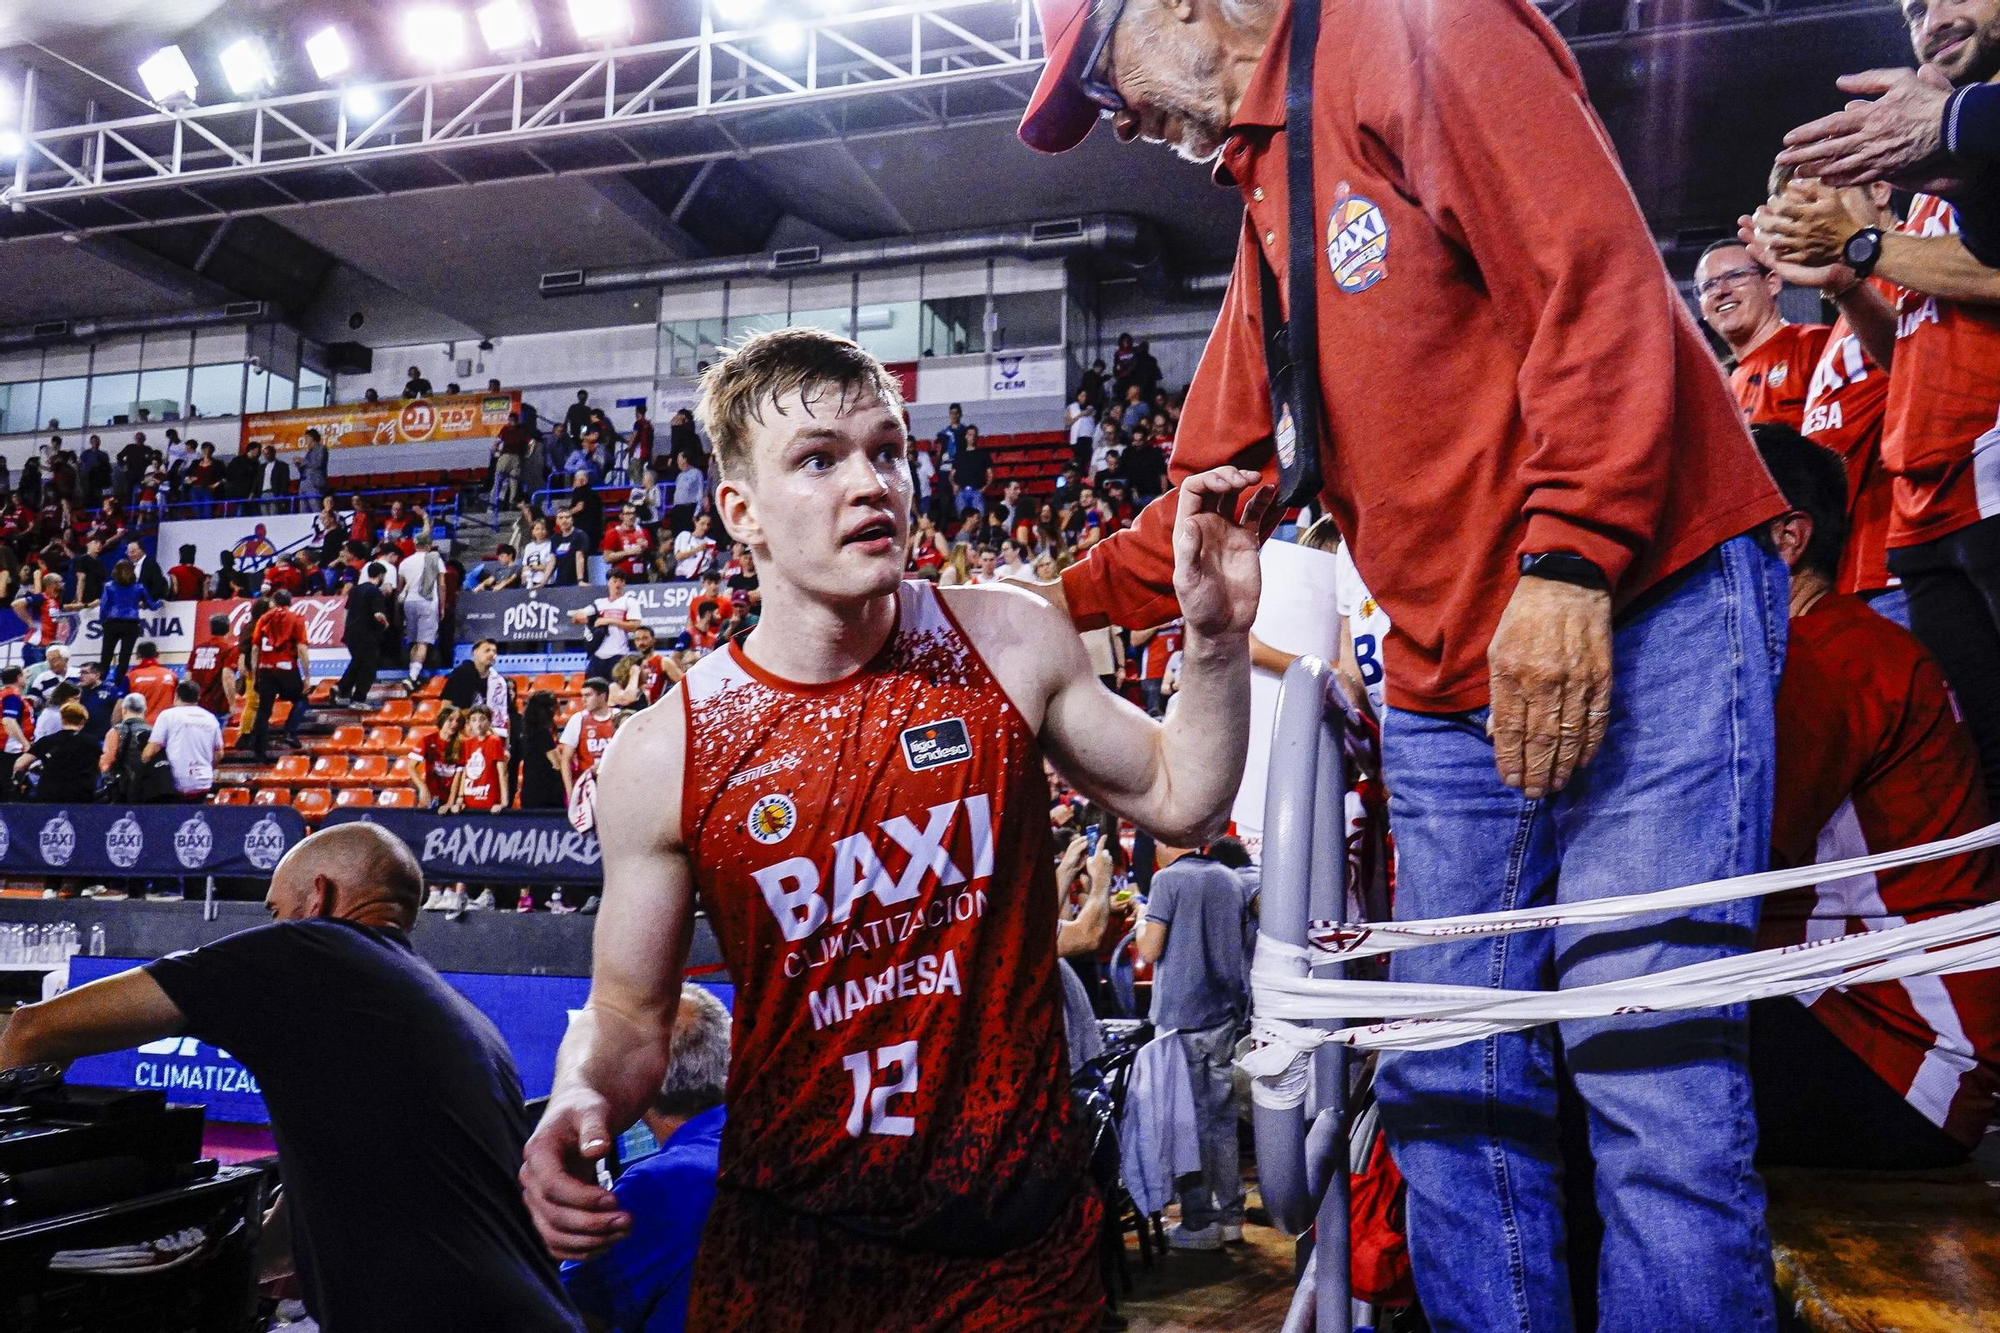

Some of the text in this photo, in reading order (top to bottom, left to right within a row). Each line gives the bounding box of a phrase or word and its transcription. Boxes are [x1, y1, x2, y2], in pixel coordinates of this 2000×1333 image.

[1327, 207, 1387, 272] BAXI
[994, 381, 1026, 391] CEM
[503, 601, 560, 636] POSTE
[909, 739, 937, 753] liga
[914, 744, 968, 764] endesa
[41, 833, 74, 847] BAXI
[107, 833, 143, 848] BAXI
[175, 833, 211, 849] BAXI
[246, 834, 285, 850] BAXI
[750, 793, 995, 942] BAXI
[808, 950, 962, 1031] MANRESA
[843, 1040, 918, 1138] 12
